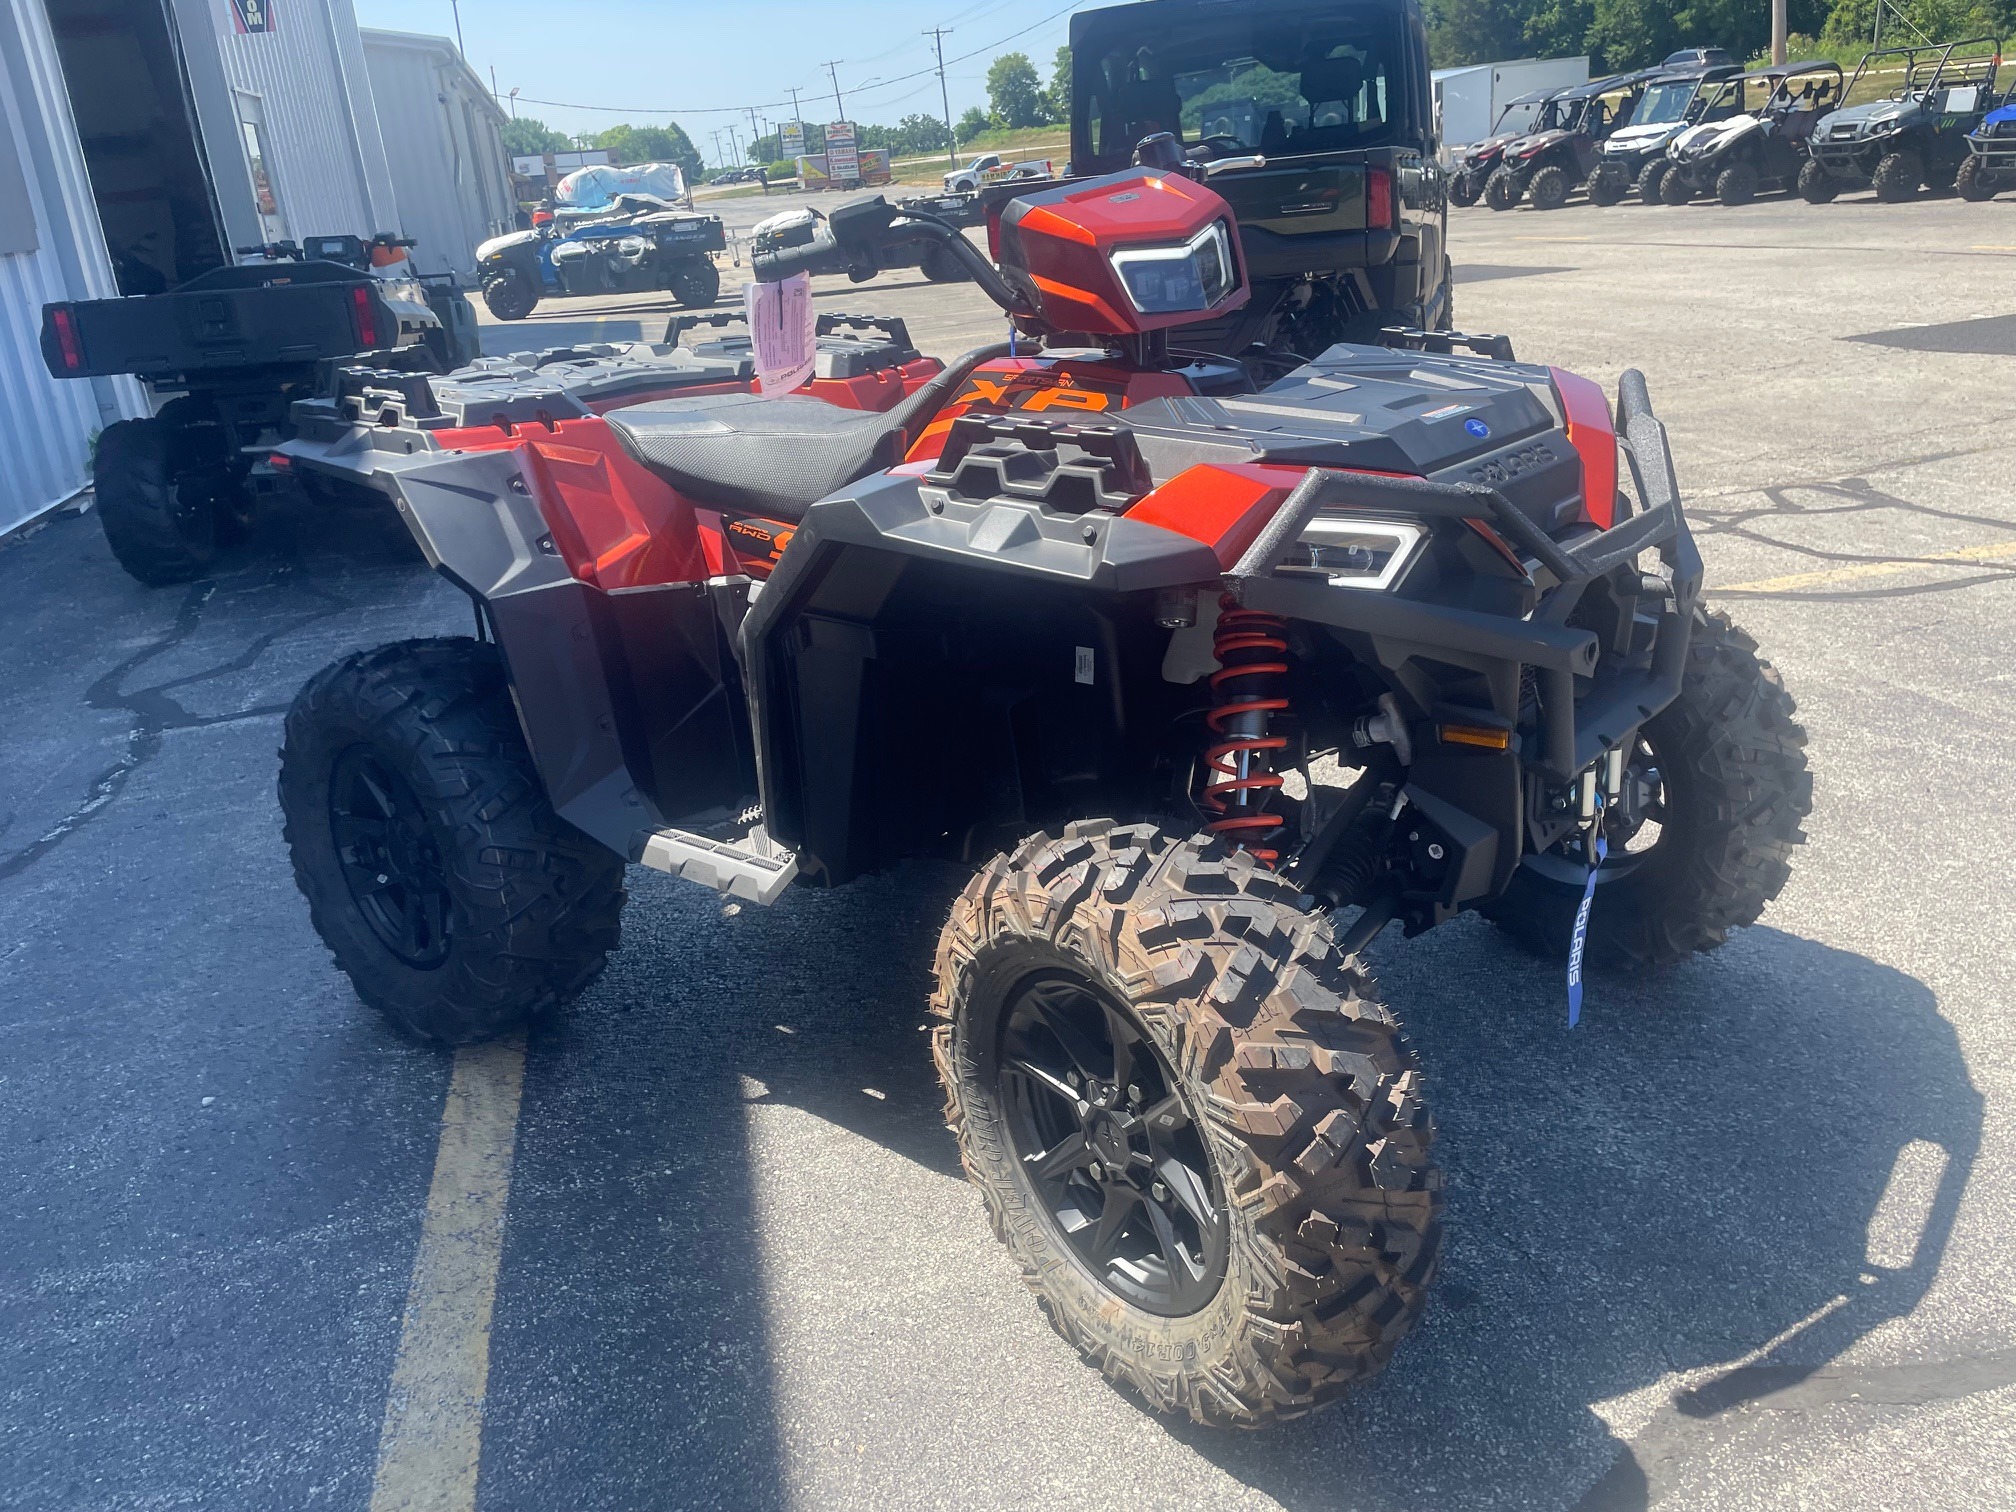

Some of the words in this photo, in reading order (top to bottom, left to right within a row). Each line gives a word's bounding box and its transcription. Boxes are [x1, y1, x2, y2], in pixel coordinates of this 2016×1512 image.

[665, 233, 707, 242] RANGER
[1001, 373, 1074, 388] SPORTSMAN
[951, 379, 1109, 412] XP
[1466, 442, 1558, 485] POLARIS
[729, 524, 771, 541] AWD
[1569, 896, 1592, 987] POLARIS
